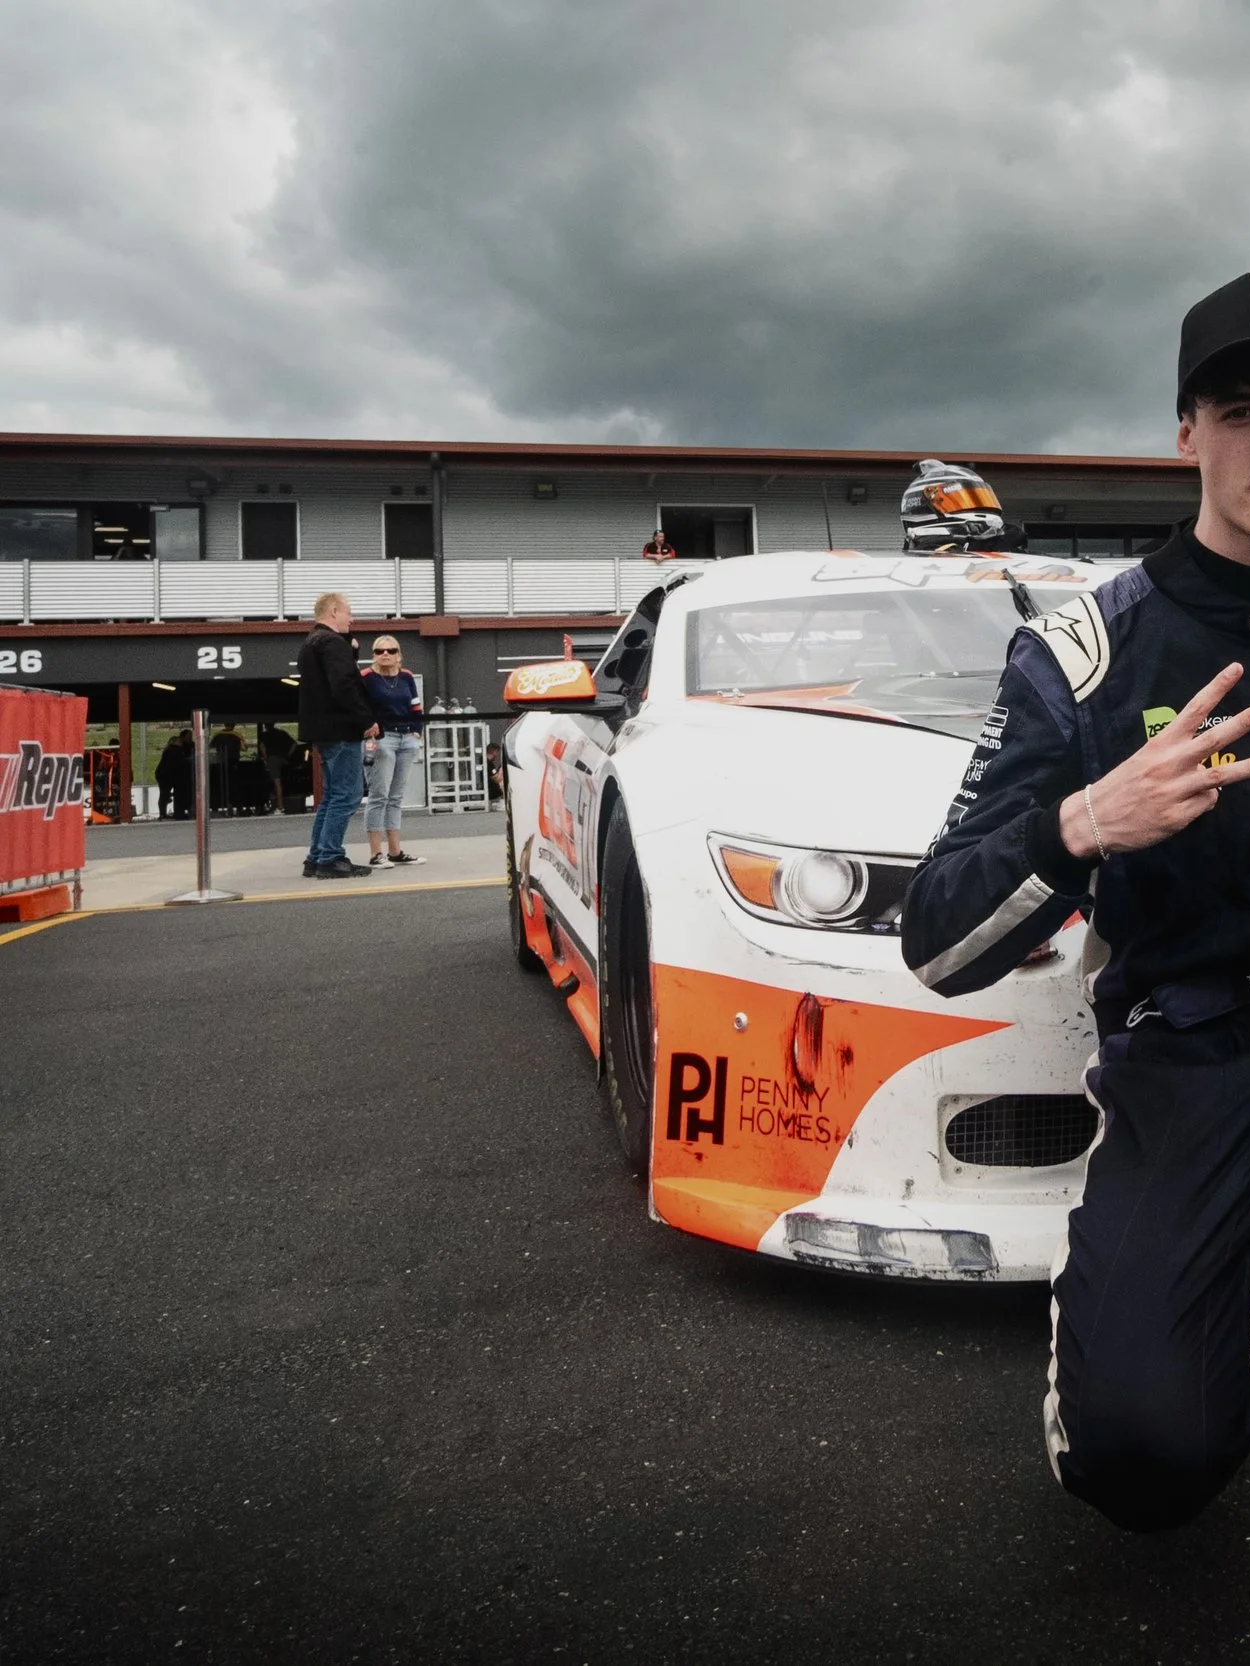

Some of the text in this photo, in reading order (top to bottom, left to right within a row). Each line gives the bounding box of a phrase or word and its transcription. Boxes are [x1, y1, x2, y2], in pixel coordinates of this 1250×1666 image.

[0, 650, 42, 673] 26
[197, 646, 242, 669] 25
[12, 740, 84, 821] Repc
[666, 1052, 728, 1146] PH
[740, 1076, 830, 1113] PENNY
[739, 1105, 832, 1144] HOMES
